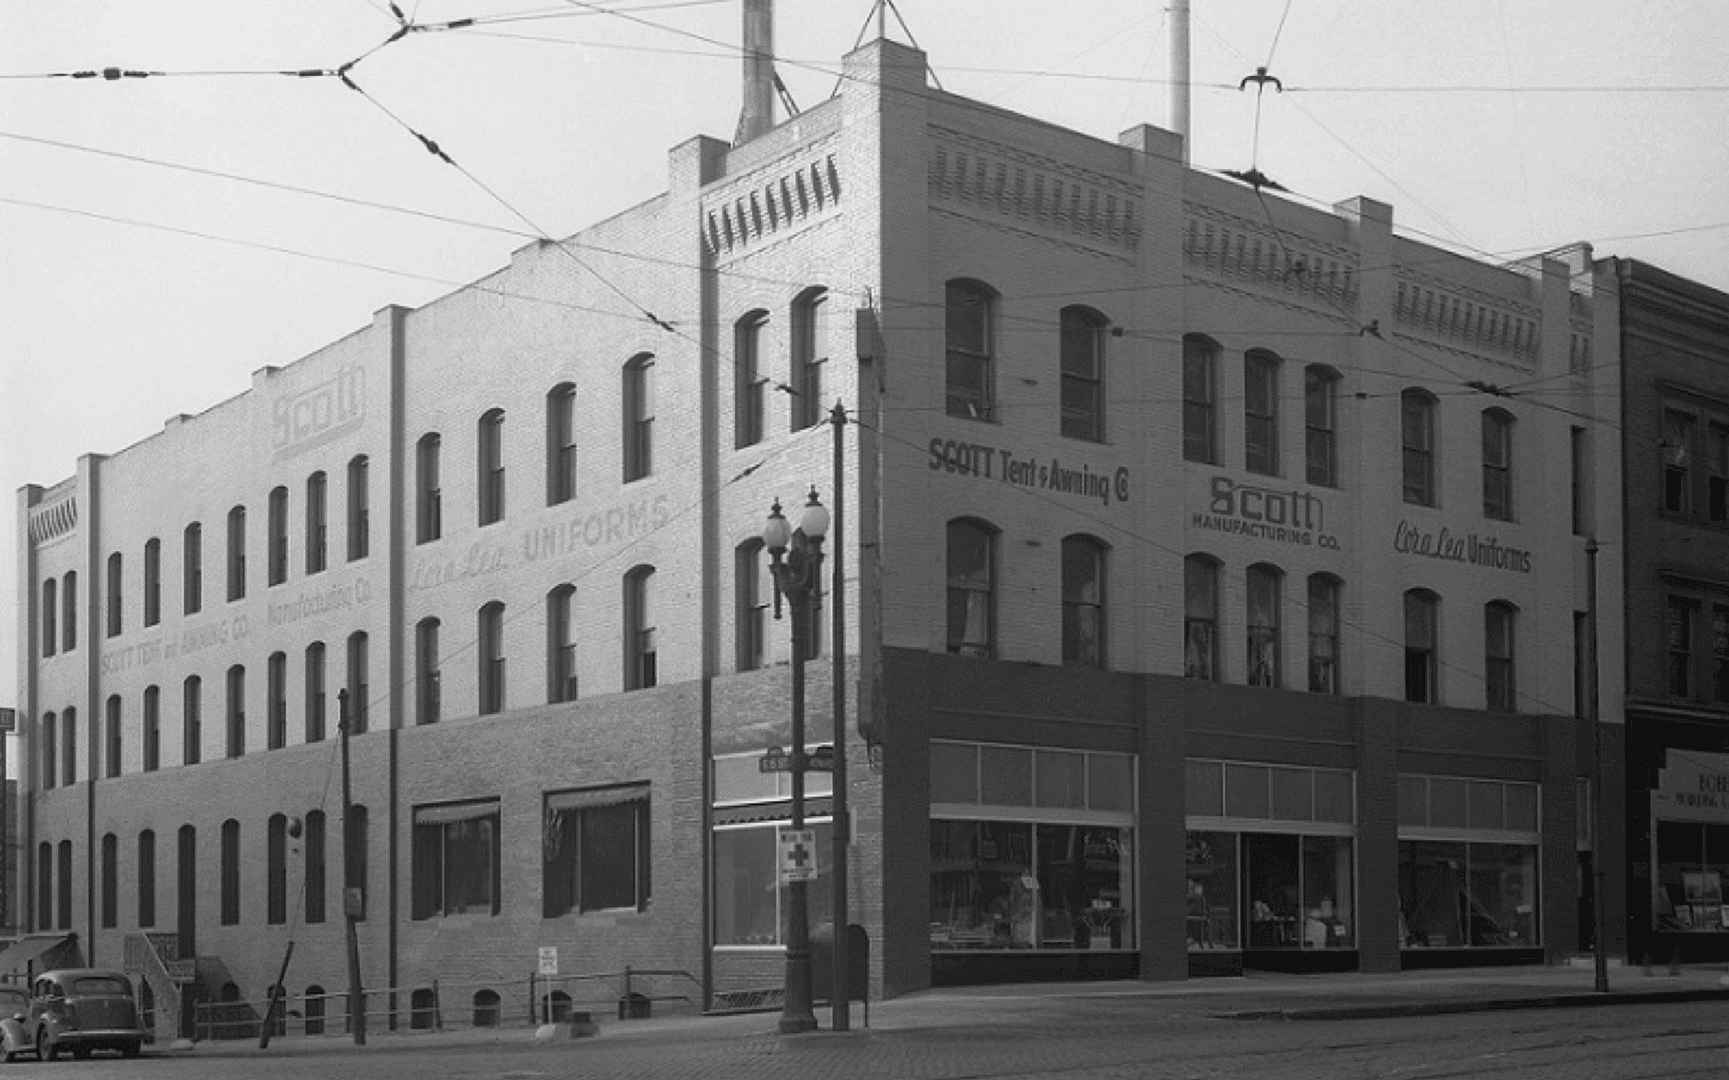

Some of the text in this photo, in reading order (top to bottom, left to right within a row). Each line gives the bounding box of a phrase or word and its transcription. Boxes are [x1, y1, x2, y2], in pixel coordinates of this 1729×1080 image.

[929, 437, 996, 479] SCOTT
[998, 449, 1038, 488] Tent
[1048, 458, 1109, 506] Awning
[524, 495, 668, 561] UNIFORMS
[1192, 513, 1313, 547] MANUFACTURING
[1210, 475, 1324, 533] Scott
[1467, 533, 1531, 573] Uniforms
